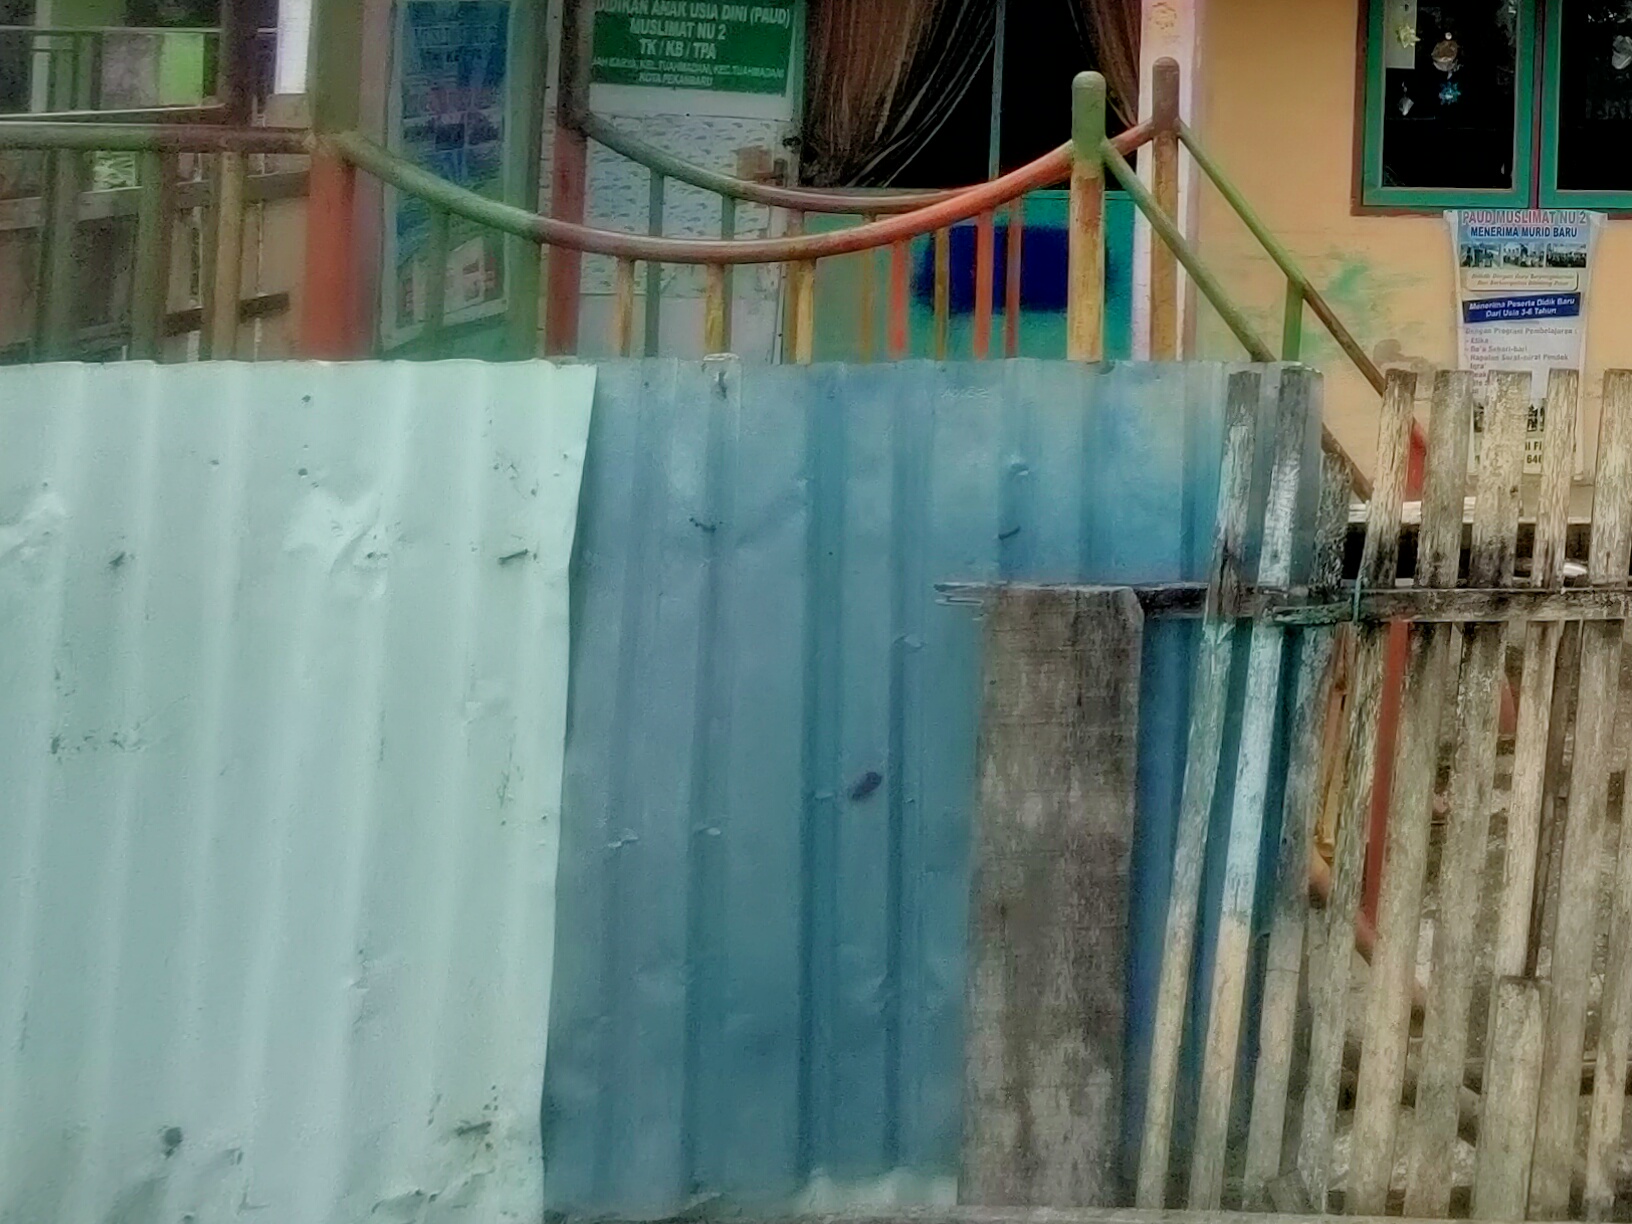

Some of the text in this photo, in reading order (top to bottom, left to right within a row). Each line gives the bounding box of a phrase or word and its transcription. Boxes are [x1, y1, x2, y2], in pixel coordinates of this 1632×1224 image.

[651, 0, 688, 18] ANAK
[690, 2, 718, 20] USIA
[721, 4, 748, 23] DINI
[750, 6, 791, 28] (PAUD)
[630, 18, 727, 40] MUSLIMAT NU 2
[640, 38, 657, 55] TK
[666, 40, 684, 57] KB
[692, 42, 717, 59] TPA
[1463, 211, 1587, 224] PAUD MUSLIMAT NU 2
[1471, 226, 1578, 237] MENERIMA MURID BARU
[1469, 296, 1575, 310] Menerima Peserta Didik Baru
[1486, 310, 1502, 318] Dari
[1534, 307, 1557, 316] Tahun
